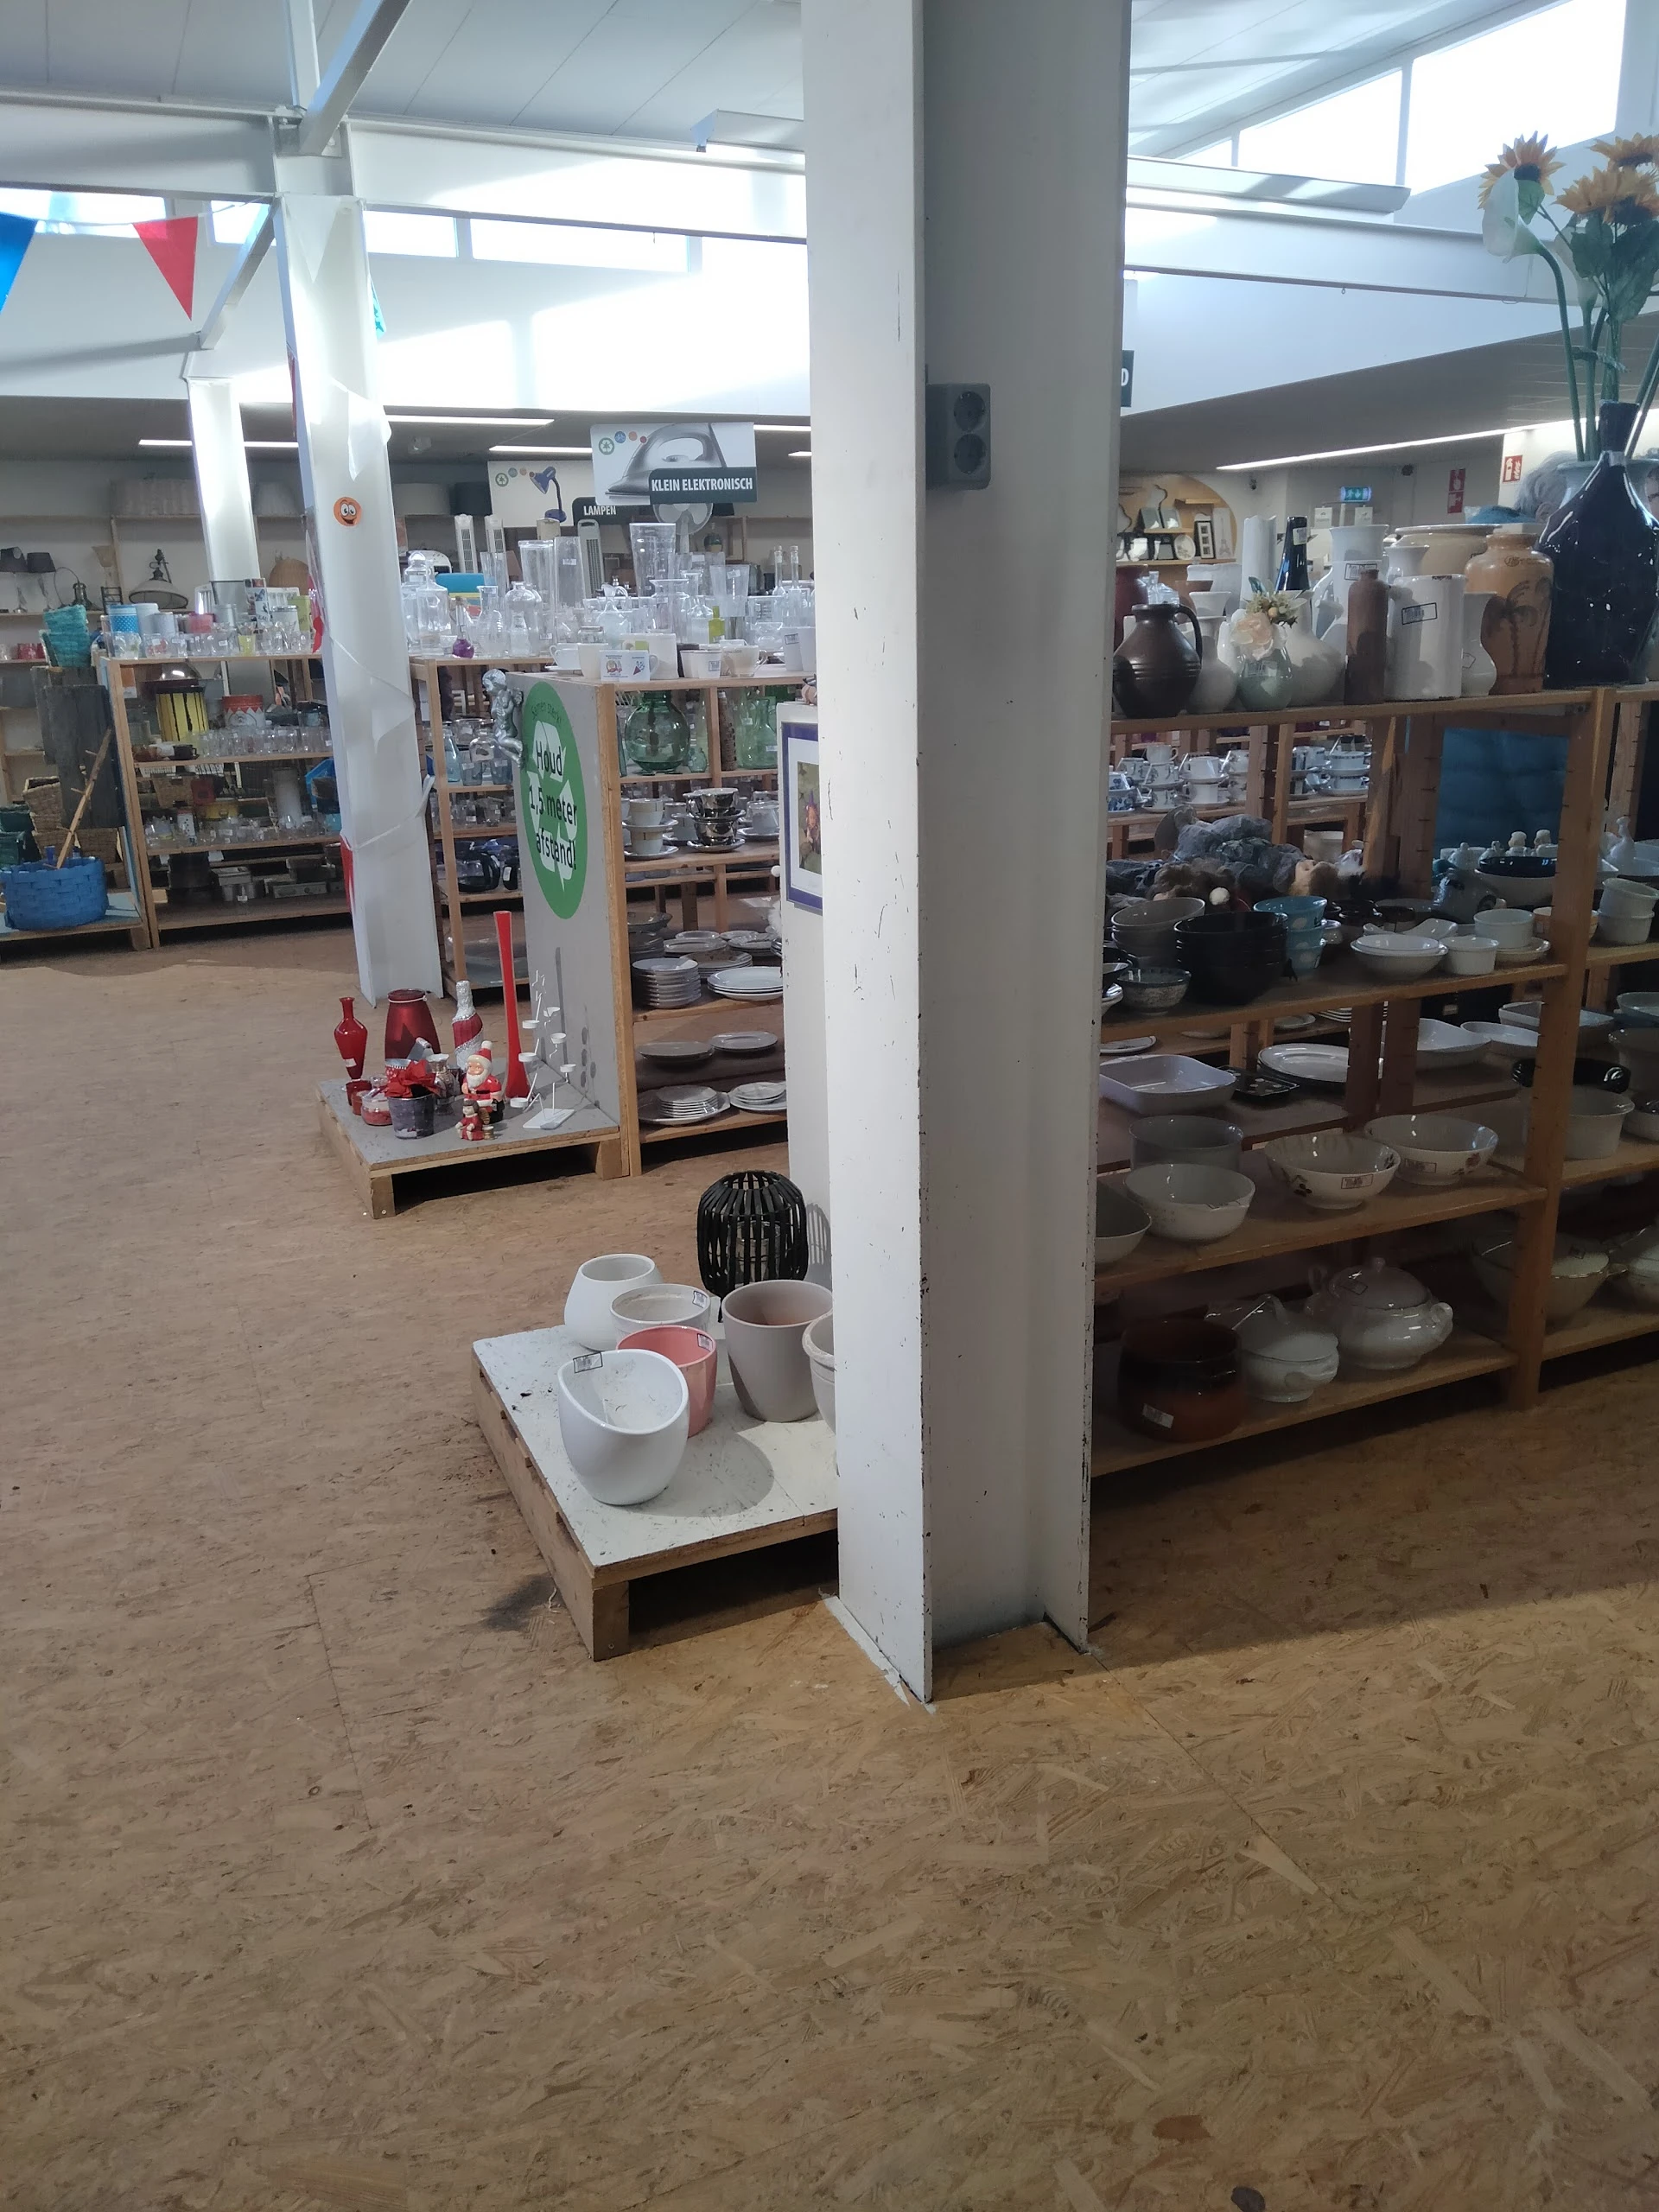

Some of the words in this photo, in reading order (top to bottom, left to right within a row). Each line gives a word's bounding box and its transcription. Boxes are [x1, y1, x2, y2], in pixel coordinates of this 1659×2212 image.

[652, 479, 680, 492] KLEIN
[682, 478, 753, 491] ELEKTRONISCH
[583, 505, 616, 516] LAMPEN
[536, 740, 563, 776] Houd
[529, 785, 544, 815] 1,5
[546, 794, 577, 826] meter
[536, 828, 577, 870] afstand!
